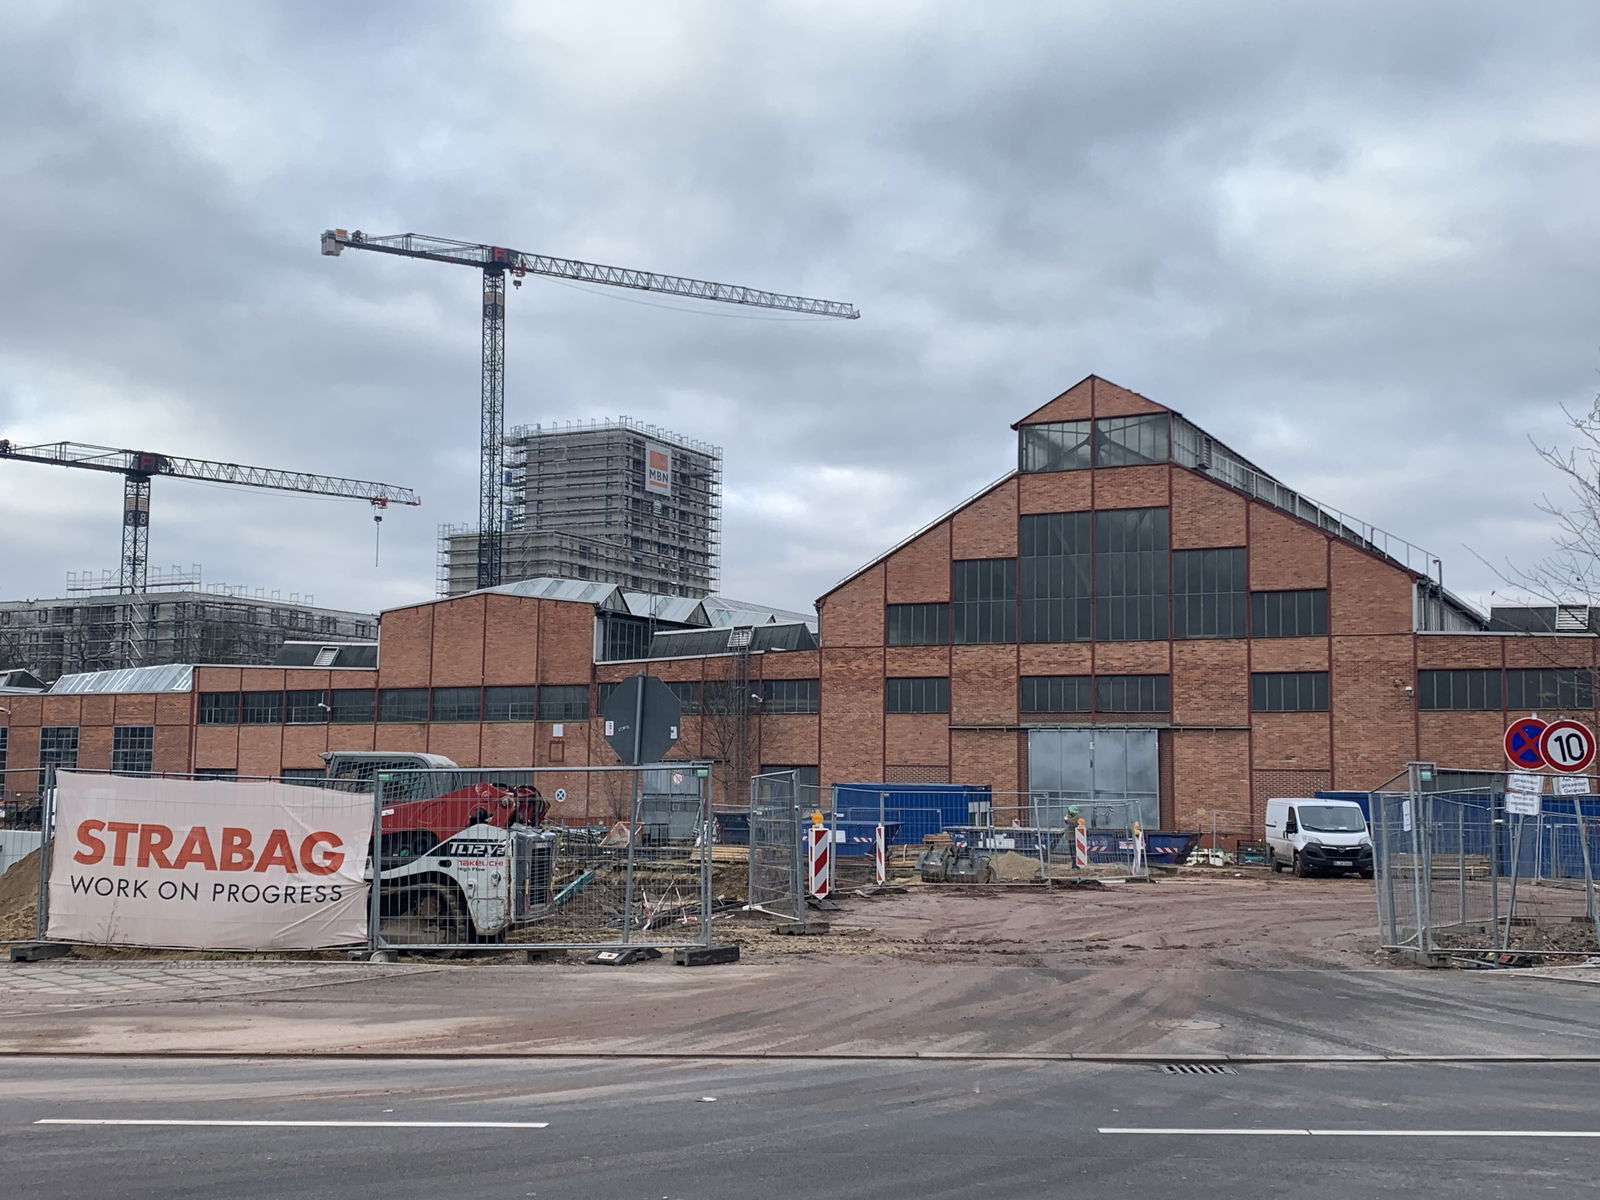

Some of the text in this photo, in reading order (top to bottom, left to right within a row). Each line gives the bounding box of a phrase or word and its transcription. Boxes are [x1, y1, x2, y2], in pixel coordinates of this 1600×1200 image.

[649, 469, 669, 483] MBN
[127, 513, 134, 524] 8
[139, 513, 146, 524] 8
[1554, 733, 1585, 762] 10
[73, 819, 345, 876] STRABAG
[70, 875, 342, 904] WORK ON PROGRESS
